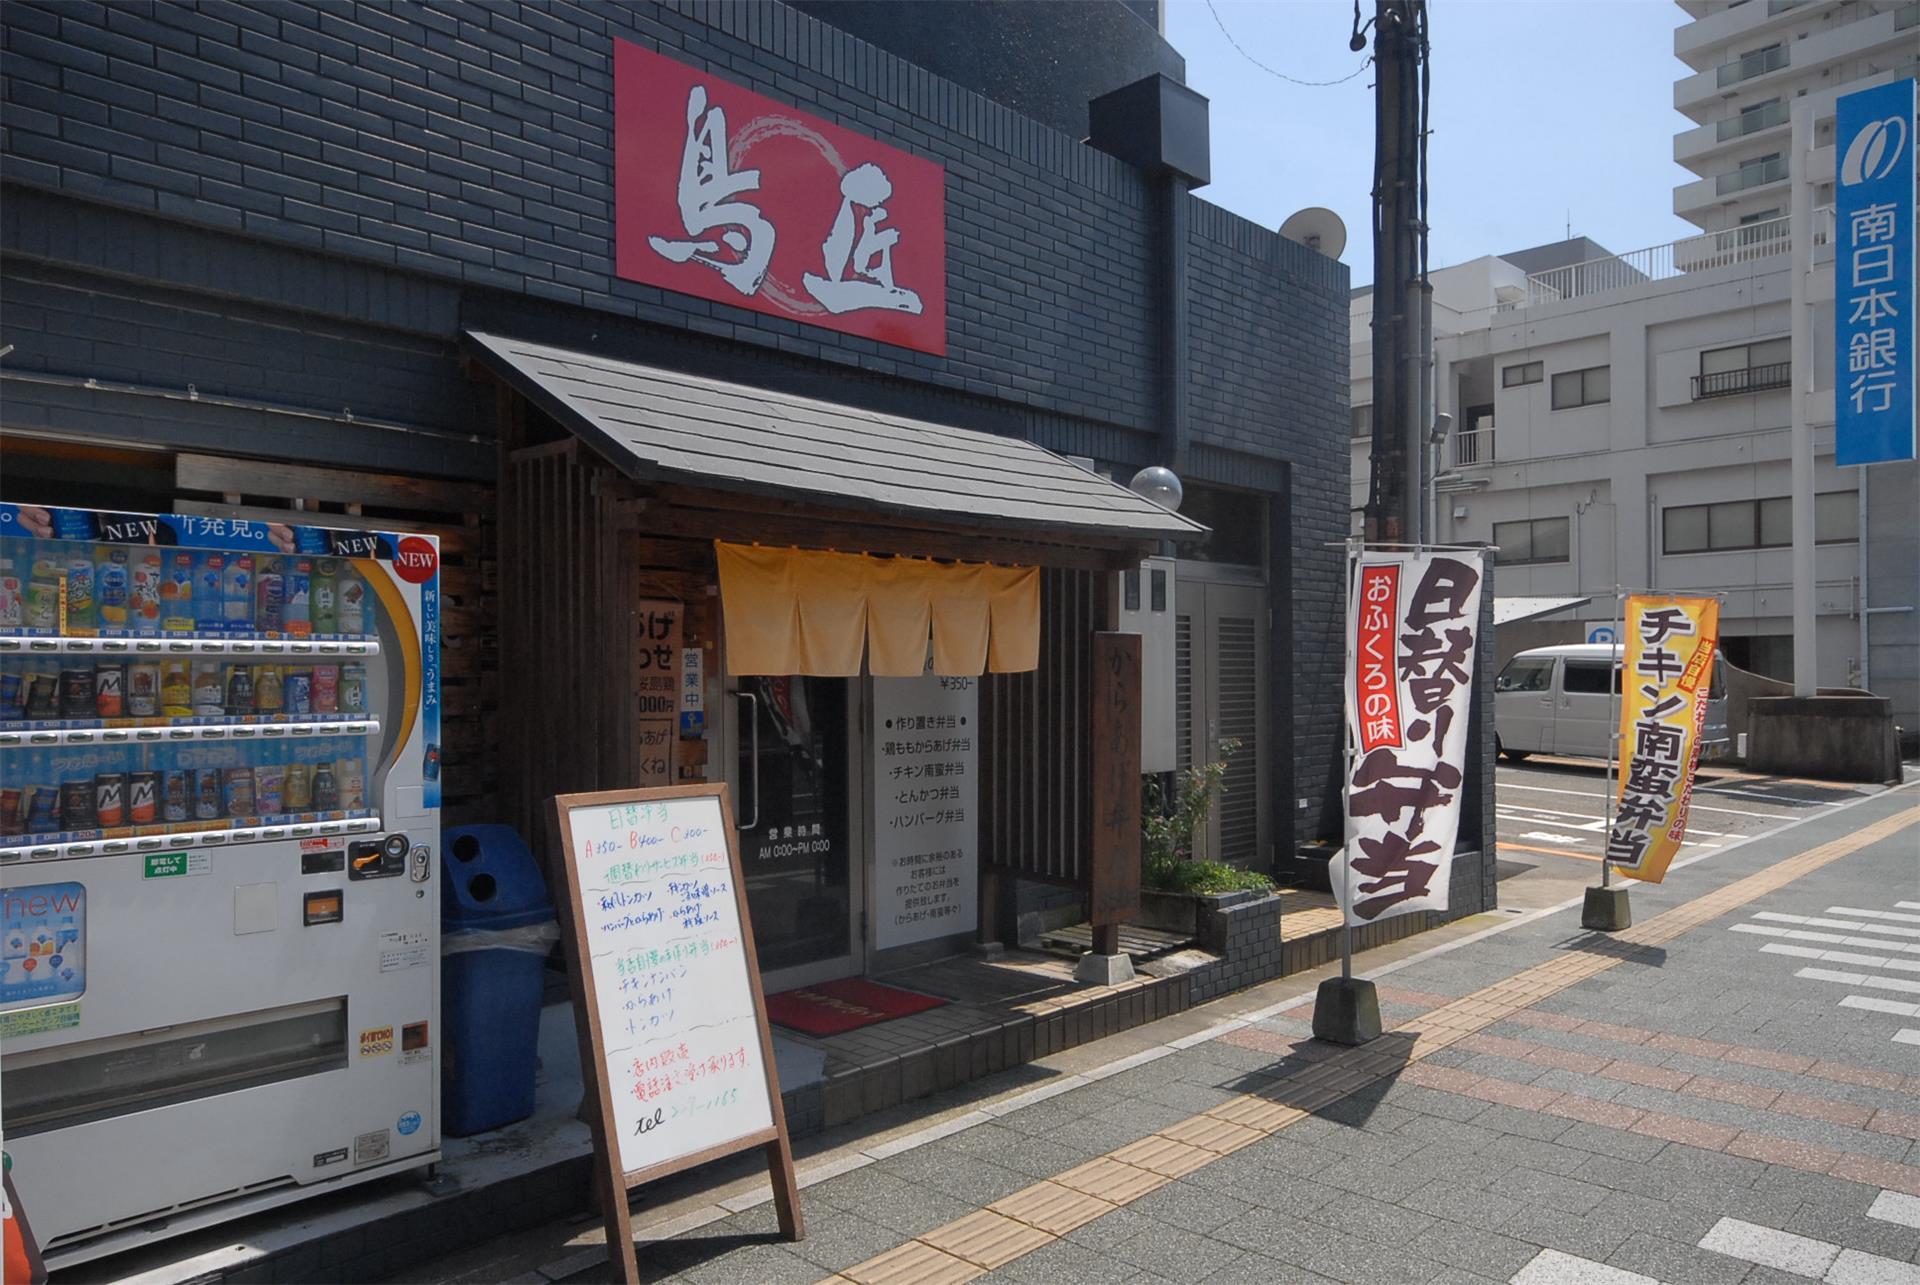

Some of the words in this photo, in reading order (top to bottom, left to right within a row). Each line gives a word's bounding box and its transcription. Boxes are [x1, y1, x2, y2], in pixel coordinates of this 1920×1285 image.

[1848, 202, 1898, 414] 南日本銀行
[106, 519, 159, 541] NEW
[336, 536, 379, 556] NEW
[396, 552, 435, 569] NEW
[1363, 574, 1395, 744] おふくろの味
[684, 653, 699, 706] 営業中
[895, 715, 957, 732] 作り置き弁当
[1607, 607, 1692, 865] チキン南蛮弁当
[1349, 557, 1480, 921] 日替り弁当
[585, 840, 593, 858] A
[629, 831, 638, 849] B
[670, 826, 680, 843] C
[759, 847, 772, 860] AM
[4, 891, 82, 920] new
[633, 1107, 666, 1136] tel
